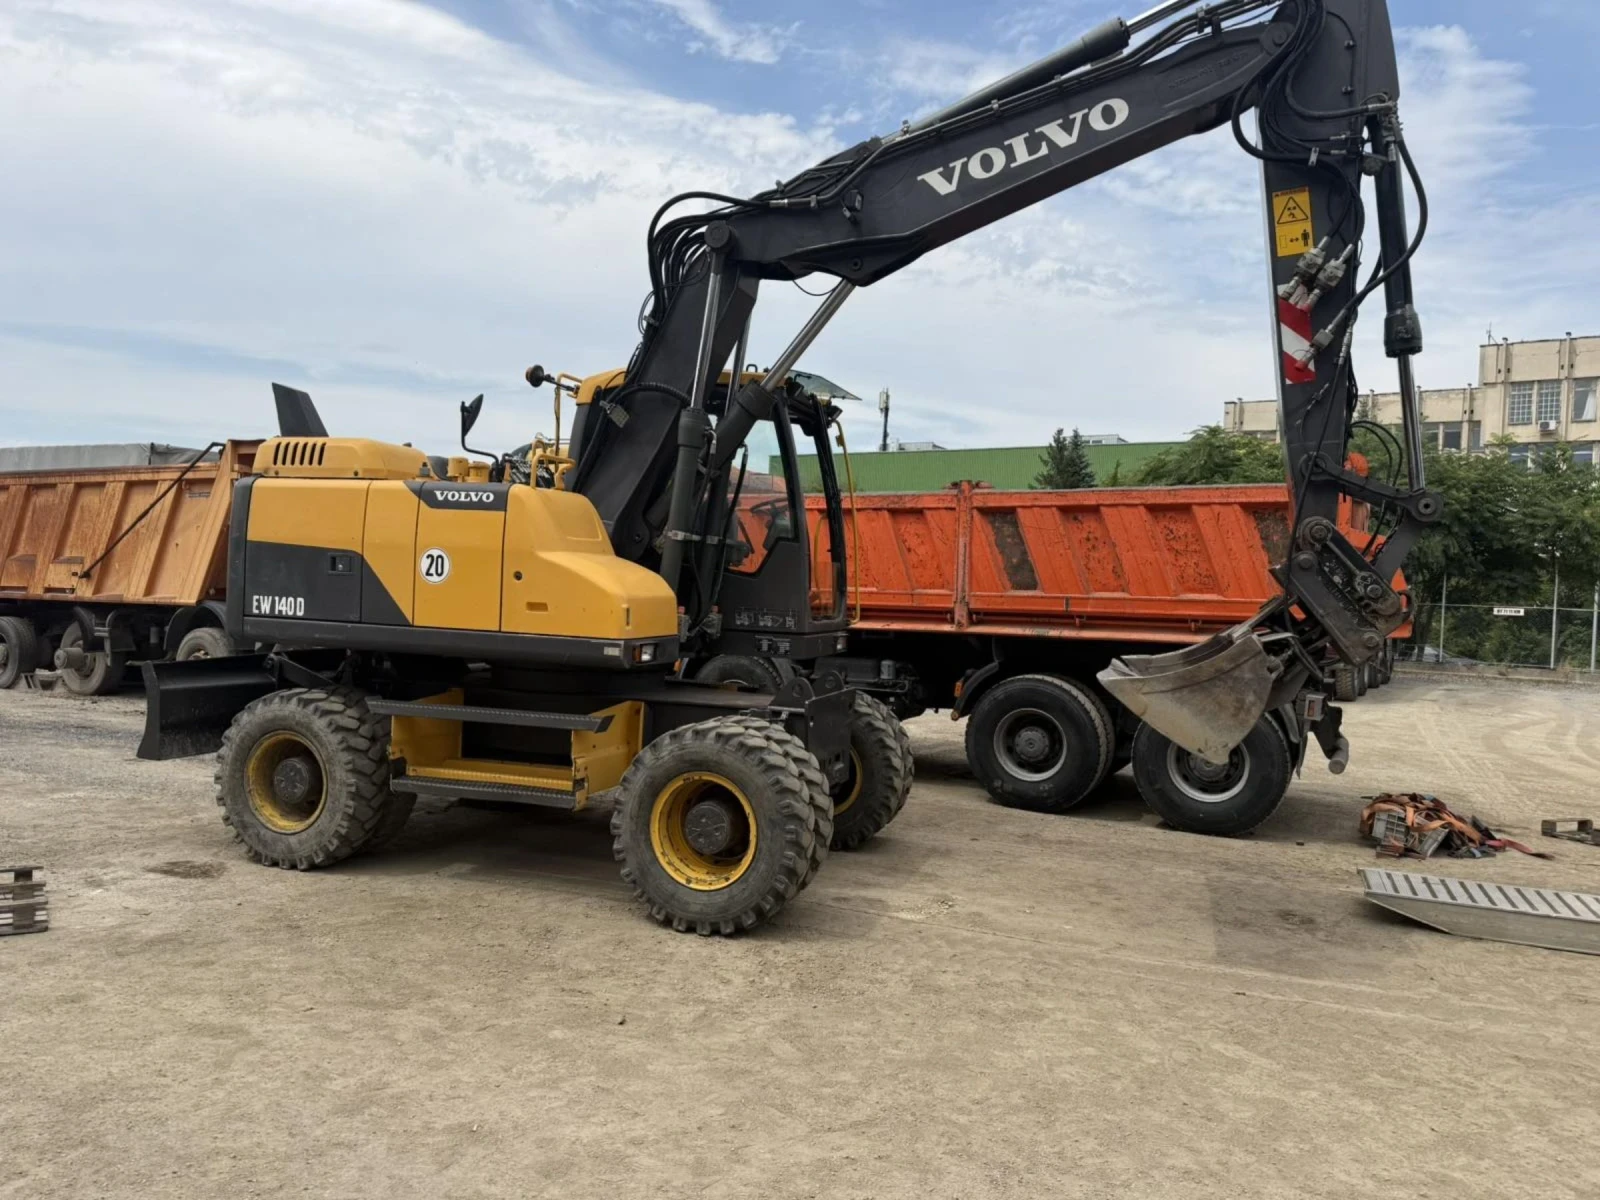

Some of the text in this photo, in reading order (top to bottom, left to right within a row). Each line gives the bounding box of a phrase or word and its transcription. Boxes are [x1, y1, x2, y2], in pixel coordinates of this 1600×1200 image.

[917, 98, 1129, 196] VOLVO
[434, 490, 495, 503] VOLVO
[425, 554, 445, 577] 20
